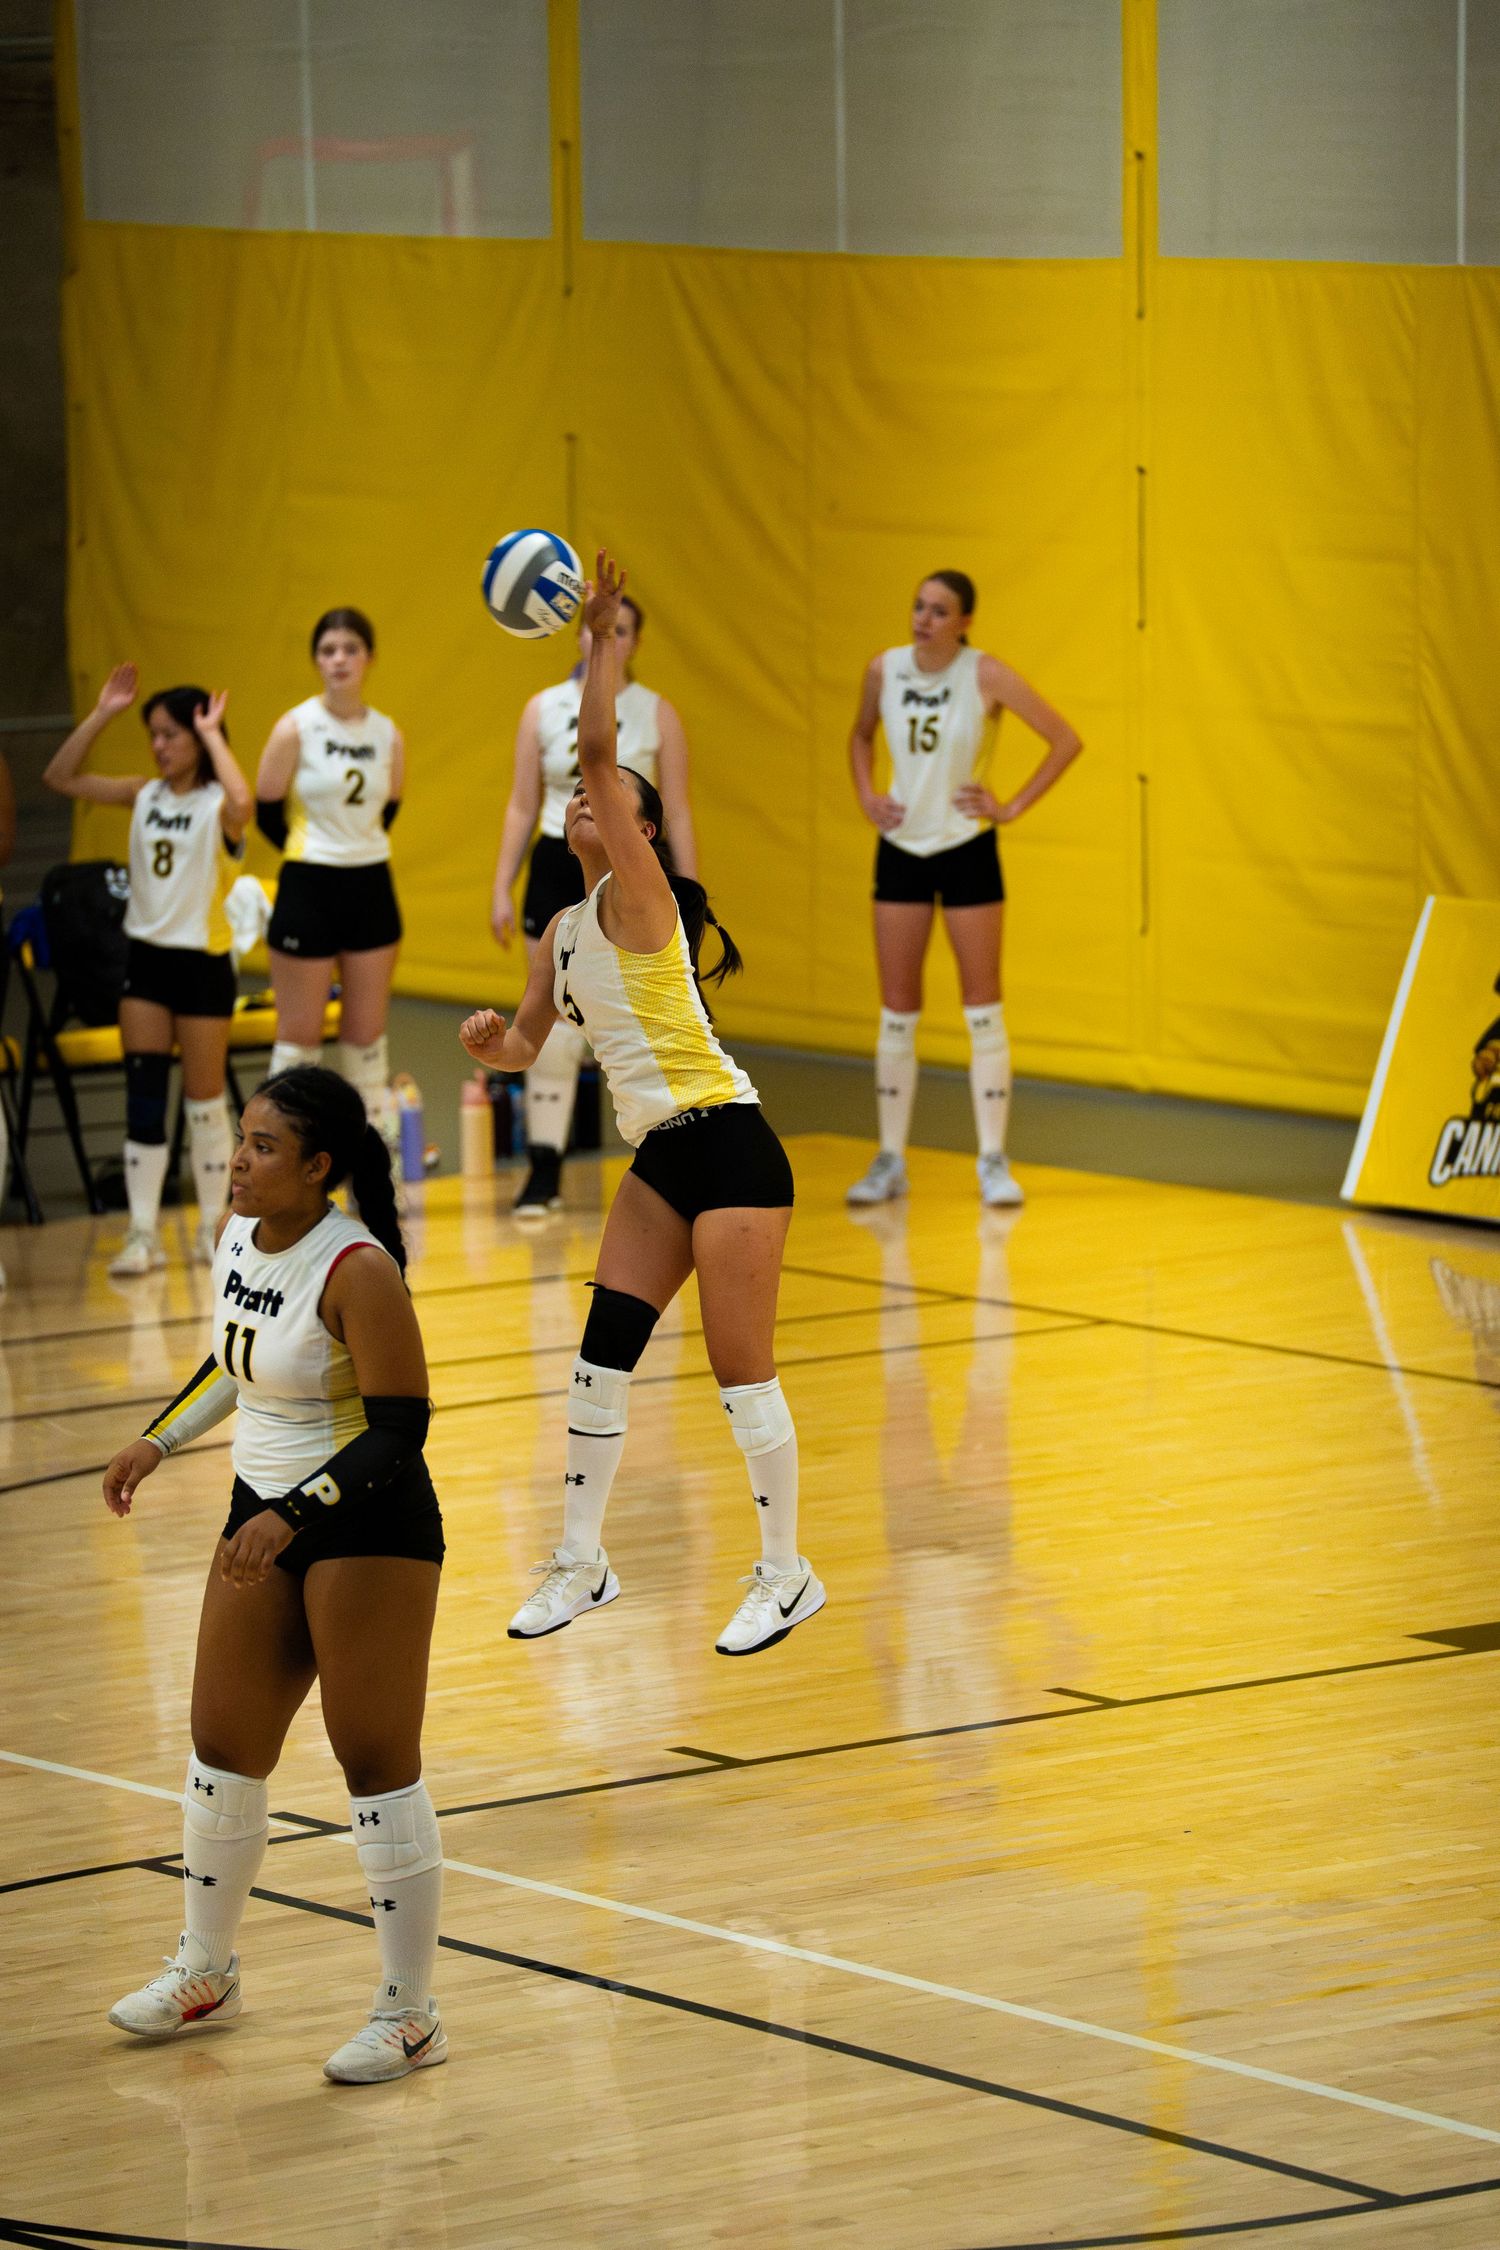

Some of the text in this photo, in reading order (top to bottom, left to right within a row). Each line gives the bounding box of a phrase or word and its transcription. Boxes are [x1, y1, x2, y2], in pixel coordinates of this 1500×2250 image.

[902, 687, 951, 707] Prat
[908, 716, 940, 753] 15
[344, 768, 365, 806] 2
[153, 839, 174, 879] 8
[223, 1268, 284, 1318] Pratt
[223, 1320, 257, 1384] 11
[300, 1472, 341, 1506] P
